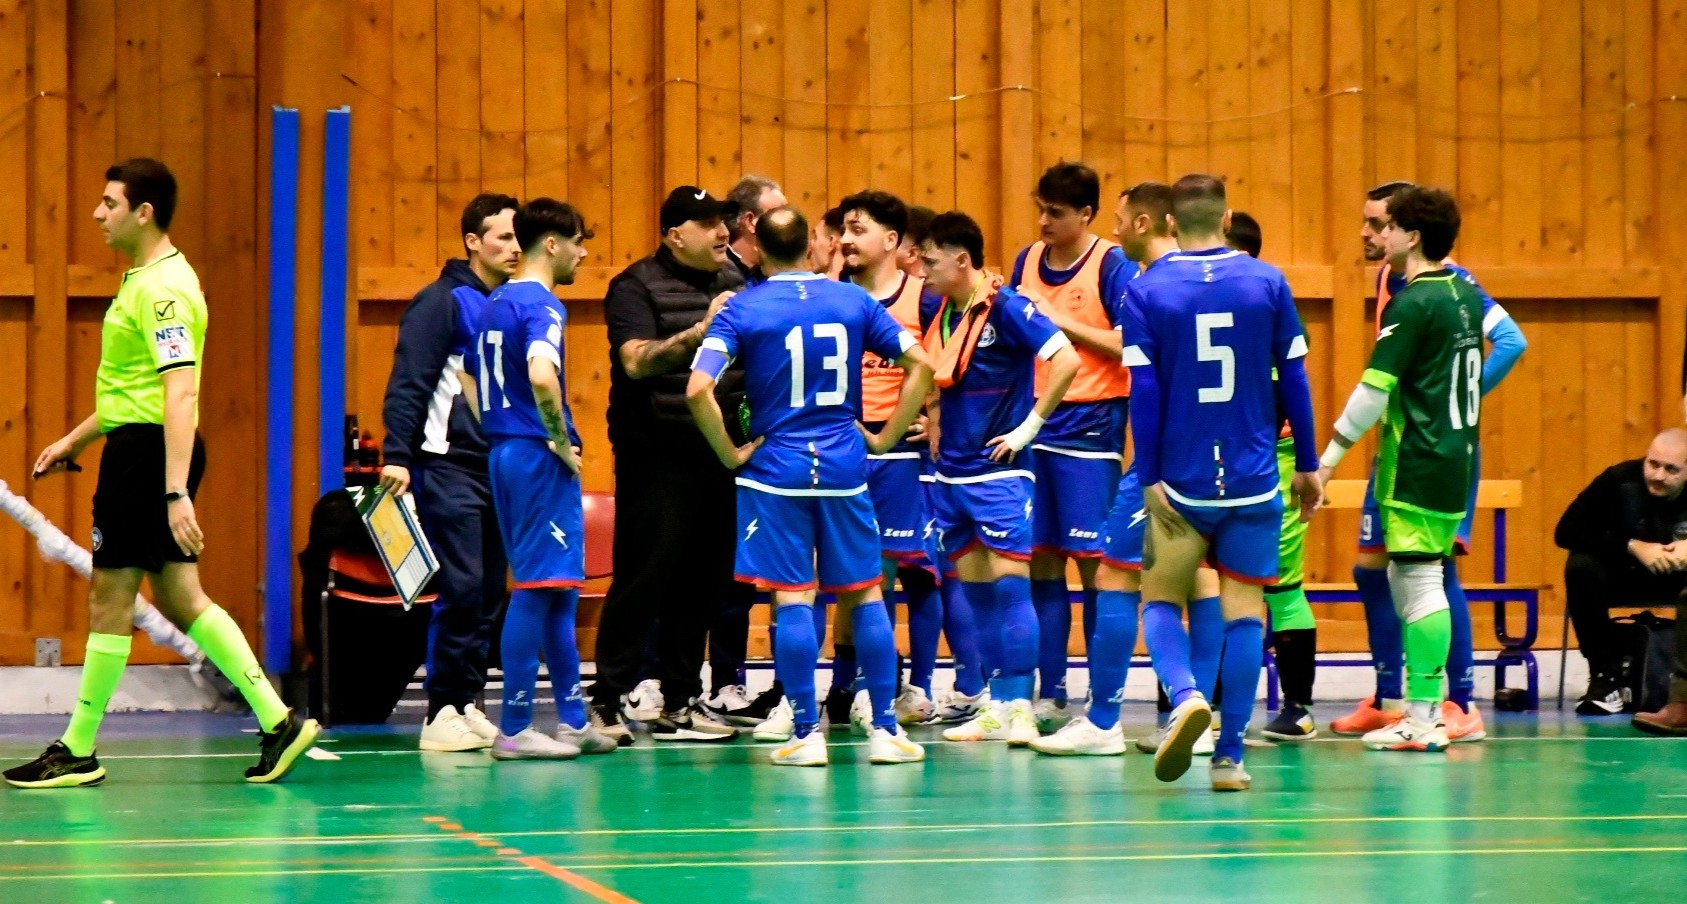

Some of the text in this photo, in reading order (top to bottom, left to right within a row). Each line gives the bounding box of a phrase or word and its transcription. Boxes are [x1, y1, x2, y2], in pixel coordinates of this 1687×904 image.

[477, 330, 511, 411] 17
[785, 322, 849, 407] 13
[1195, 312, 1235, 403] 5
[1449, 347, 1482, 430] 18
[883, 528, 915, 538] Zeus
[1068, 528, 1099, 539] Zeus
